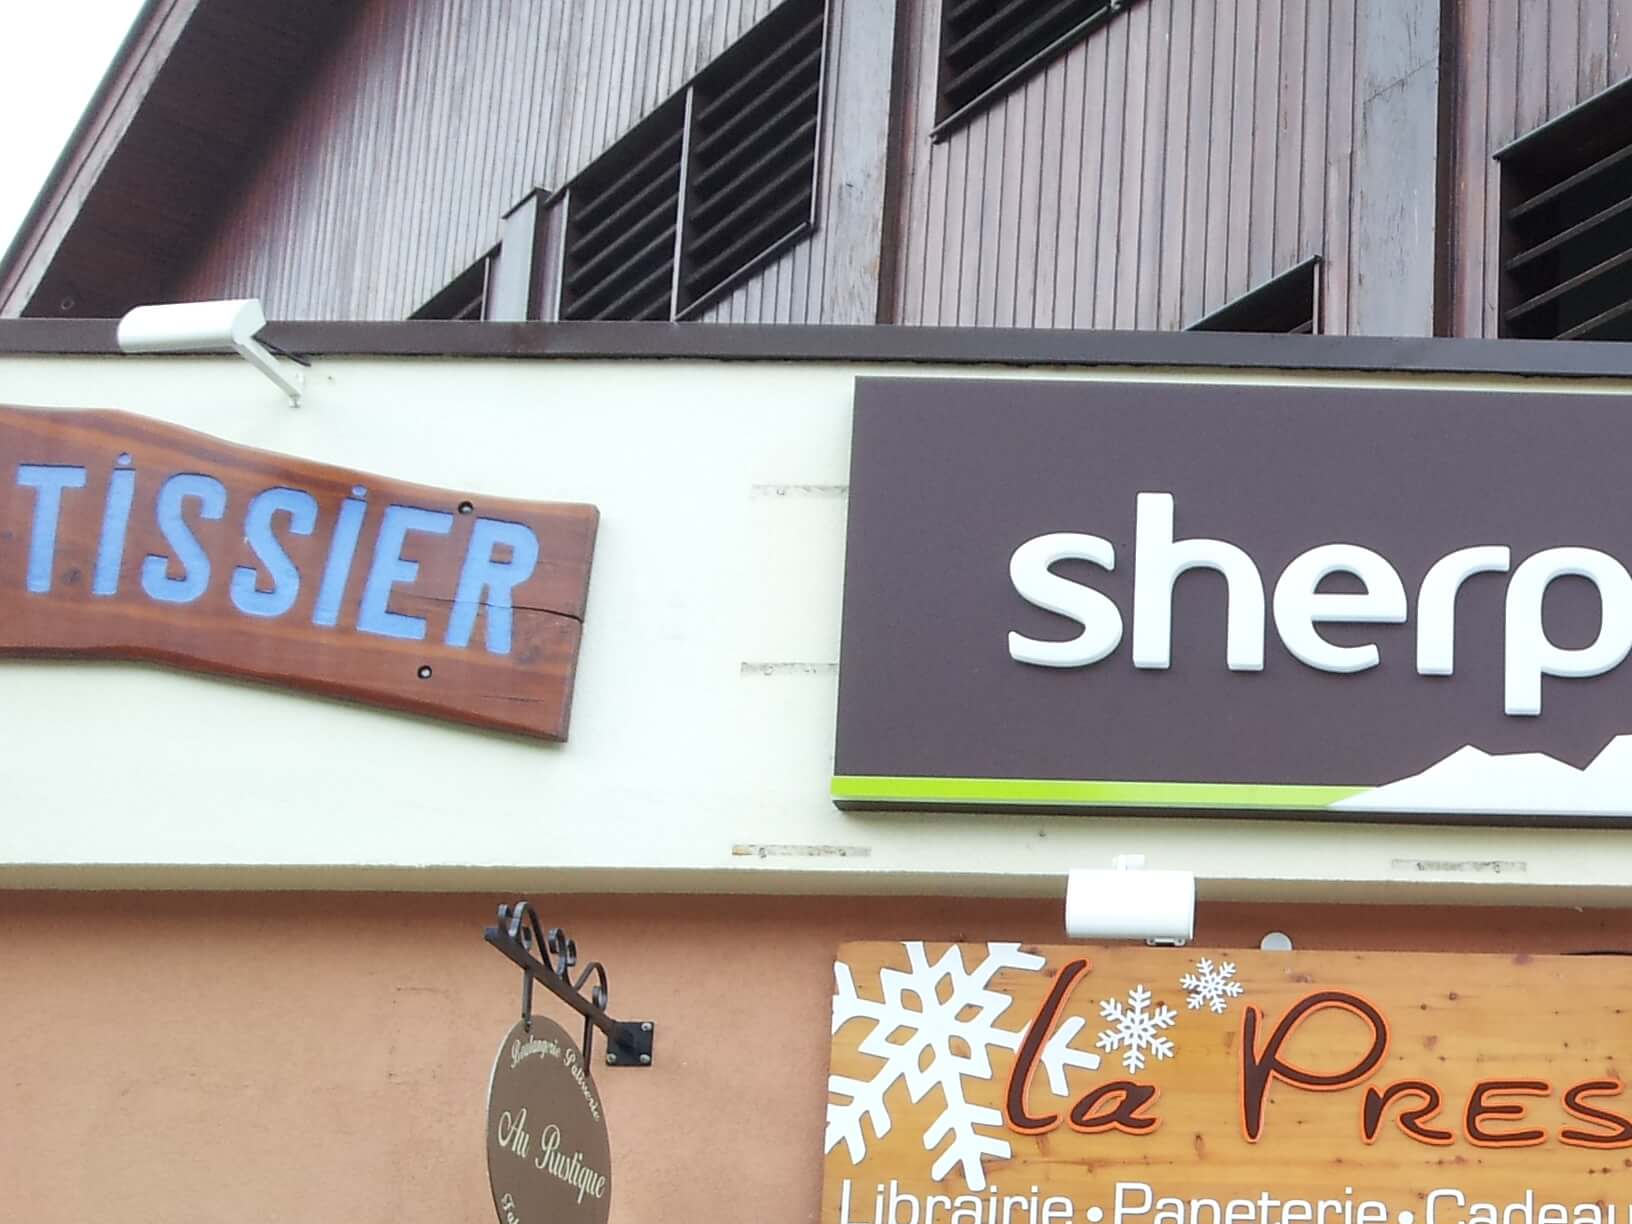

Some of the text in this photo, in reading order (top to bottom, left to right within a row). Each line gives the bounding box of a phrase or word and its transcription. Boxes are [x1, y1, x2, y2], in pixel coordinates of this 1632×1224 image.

[16, 450, 541, 655] TISSIER
[498, 1108, 606, 1204] Au Rustique
